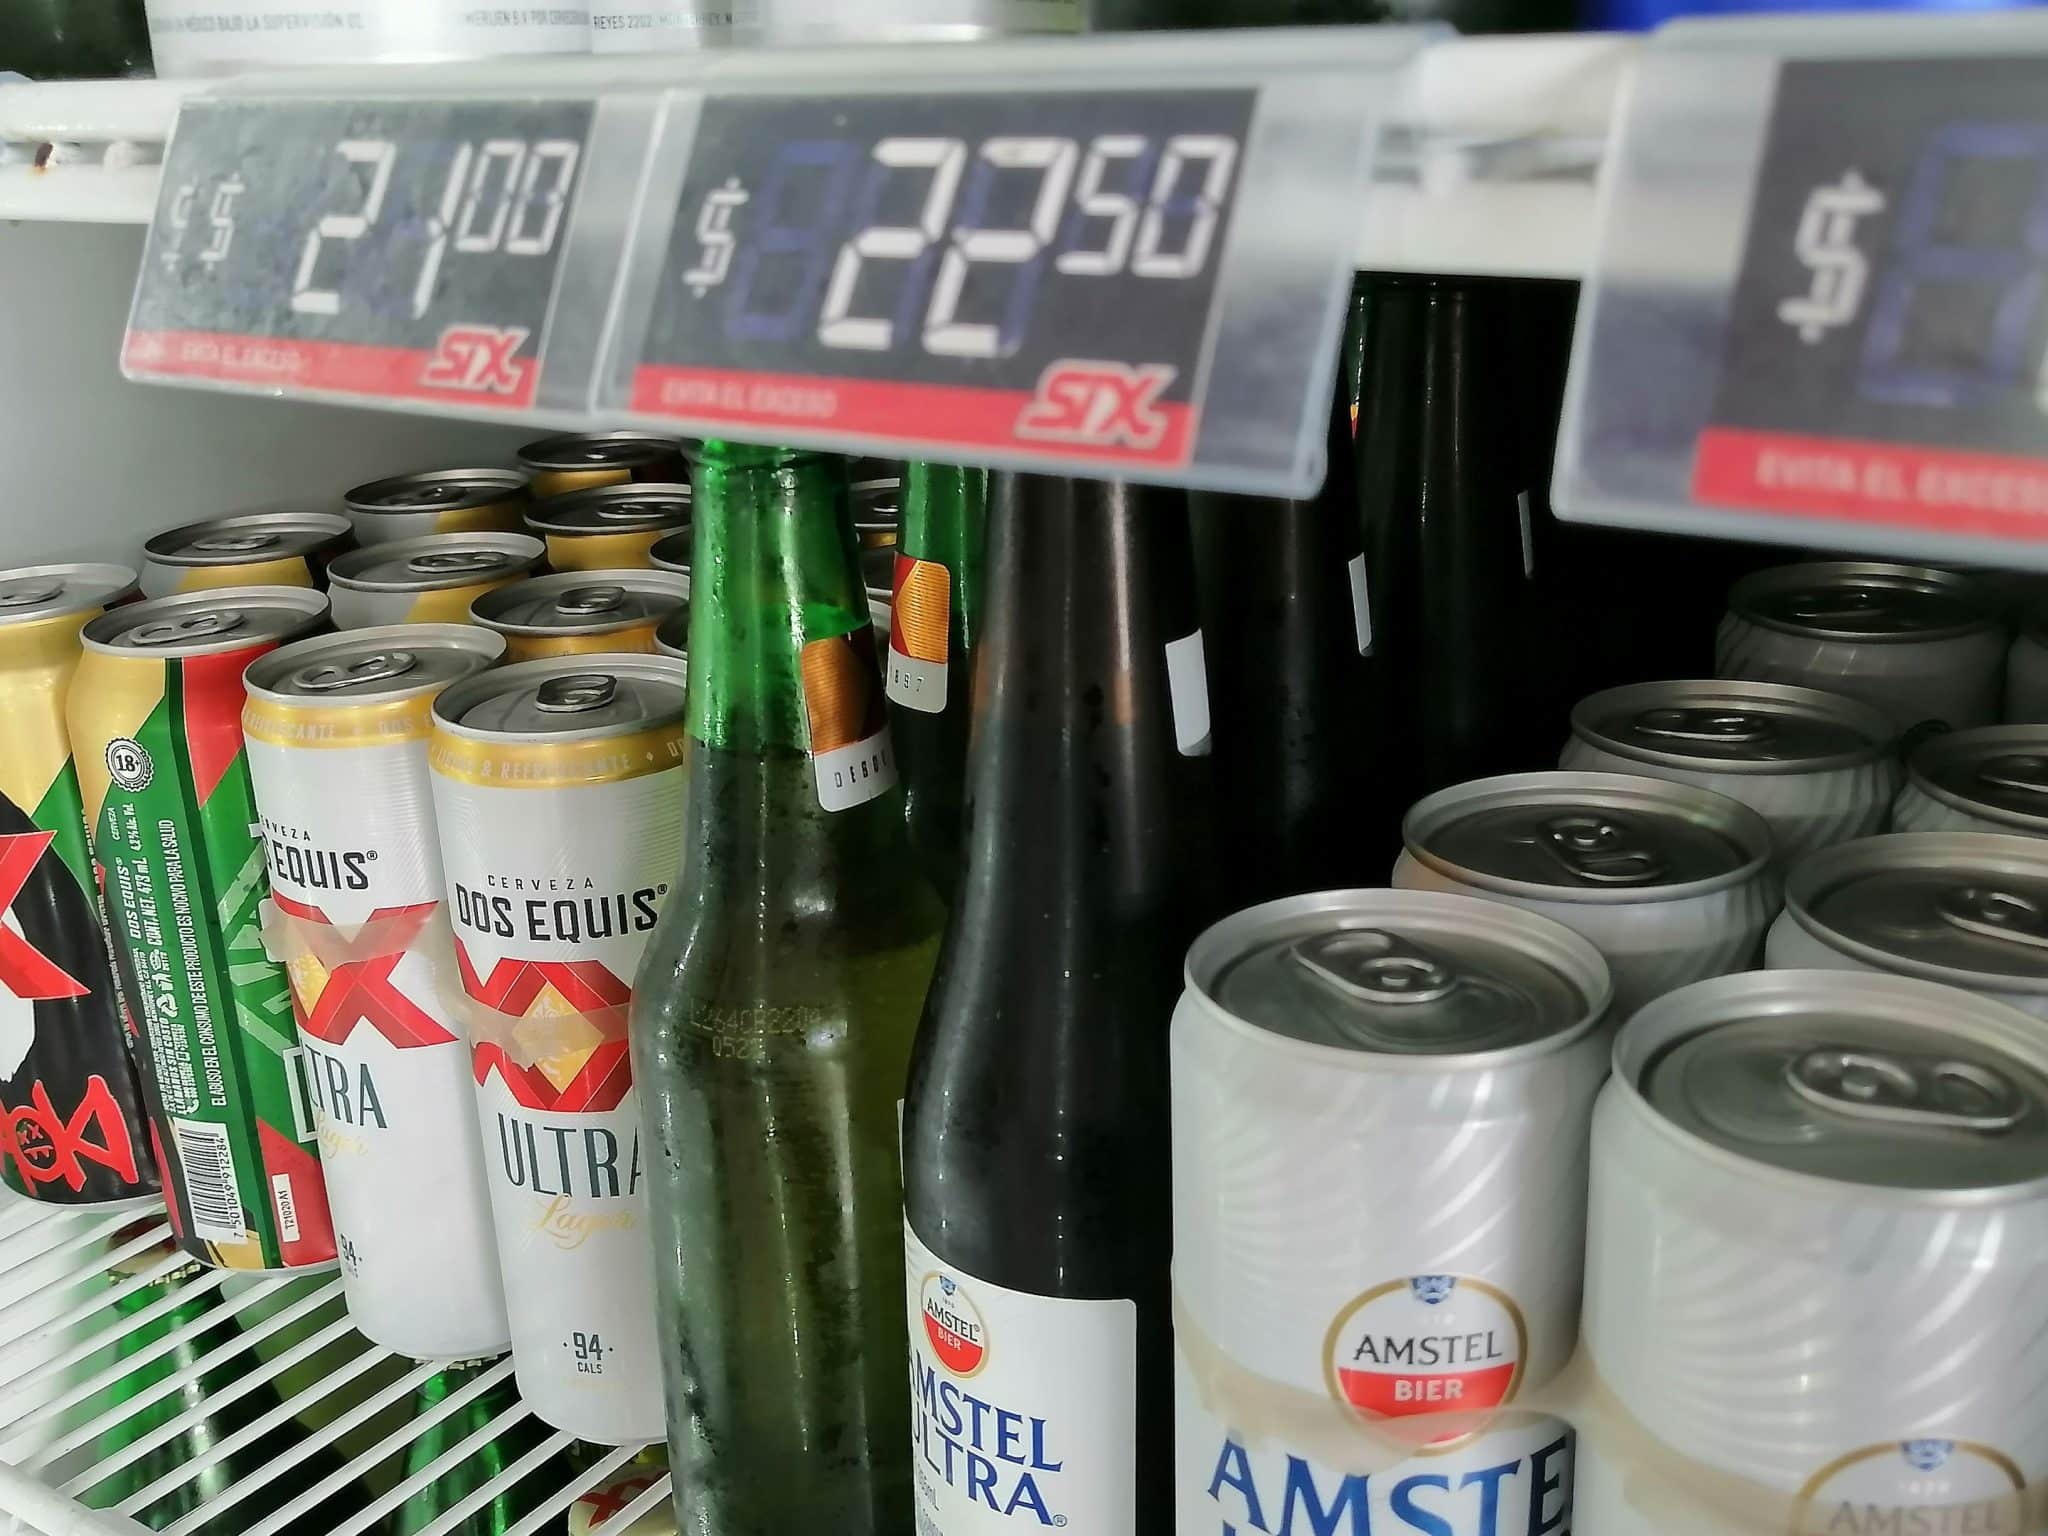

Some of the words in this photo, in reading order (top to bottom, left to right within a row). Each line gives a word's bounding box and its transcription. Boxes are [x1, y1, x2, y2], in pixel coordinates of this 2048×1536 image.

[683, 178, 749, 298] $
[1776, 164, 1886, 344] $
[107, 806, 121, 840] CERVEZA
[158, 818, 177, 848] SALUD
[131, 856, 148, 874] mL
[163, 847, 179, 860] LA
[134, 872, 153, 894] 473
[166, 860, 184, 883] PARA
[488, 875, 593, 891] CERVEZA
[170, 883, 190, 915] NOCIVO
[456, 883, 514, 938] DOS
[126, 910, 141, 940] DOS
[176, 914, 192, 927] ES
[178, 925, 200, 971] PRODUCTO
[187, 970, 205, 992] ESTE
[192, 991, 207, 1004] DE
[159, 1016, 173, 1048] COSTO
[193, 1003, 215, 1045] CONSUMO
[202, 1045, 217, 1055] EL
[204, 1056, 219, 1069] EN
[206, 1068, 224, 1096] ABUSO
[211, 1095, 227, 1106] EL
[937, 1327, 961, 1351] BIER
[1353, 1329, 1503, 1366] AMSTEL
[577, 1361, 603, 1375] CALS
[1394, 1377, 1464, 1402] BIER
[909, 1348, 1063, 1473] MSTEL
[1207, 1434, 1570, 1536] AMSTE
